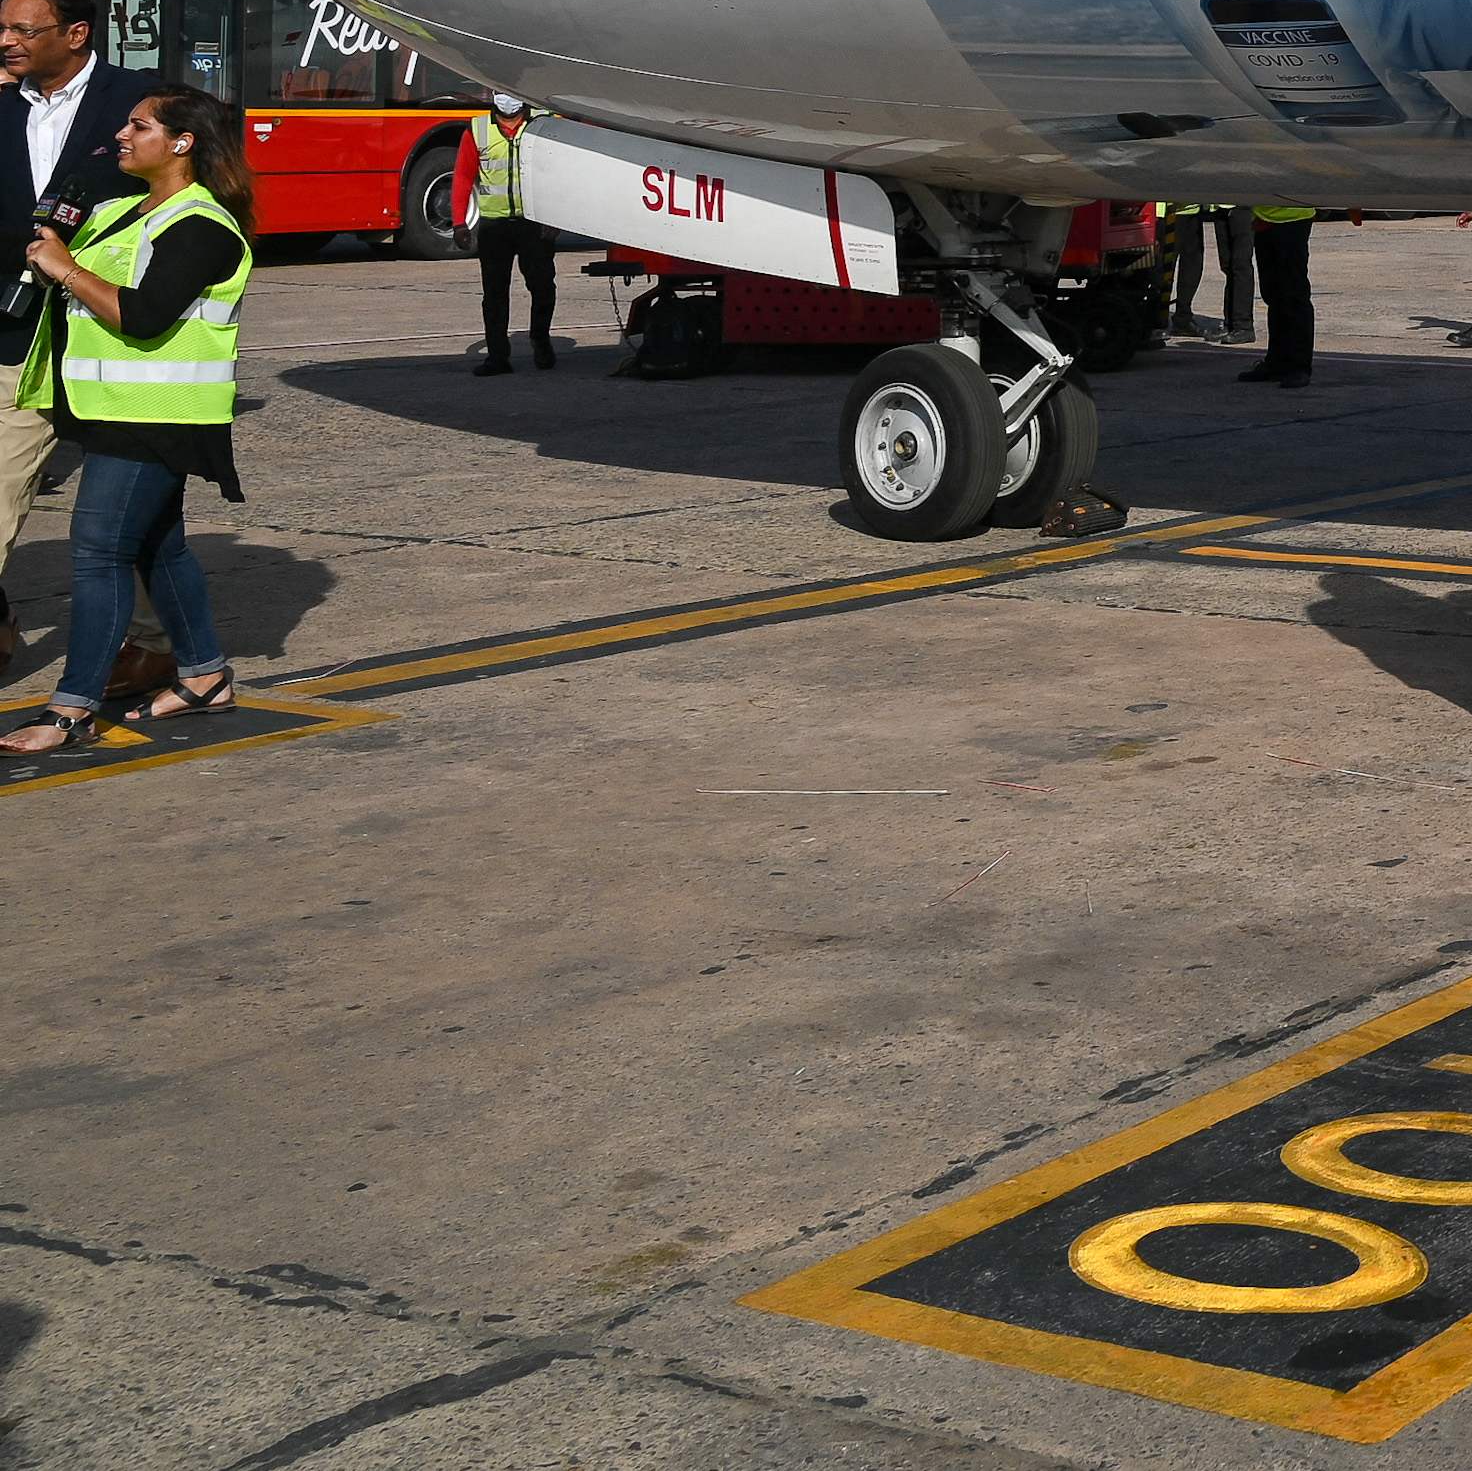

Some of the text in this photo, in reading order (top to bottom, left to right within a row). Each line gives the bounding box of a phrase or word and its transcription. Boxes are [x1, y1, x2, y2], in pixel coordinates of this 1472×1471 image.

[1239, 30, 1317, 45] VACCINE
[1247, 53, 1304, 67] COVID
[1319, 53, 1340, 65] 19
[642, 165, 724, 222] SLM
[57, 203, 80, 219] ET
[53, 214, 77, 226] NOW
